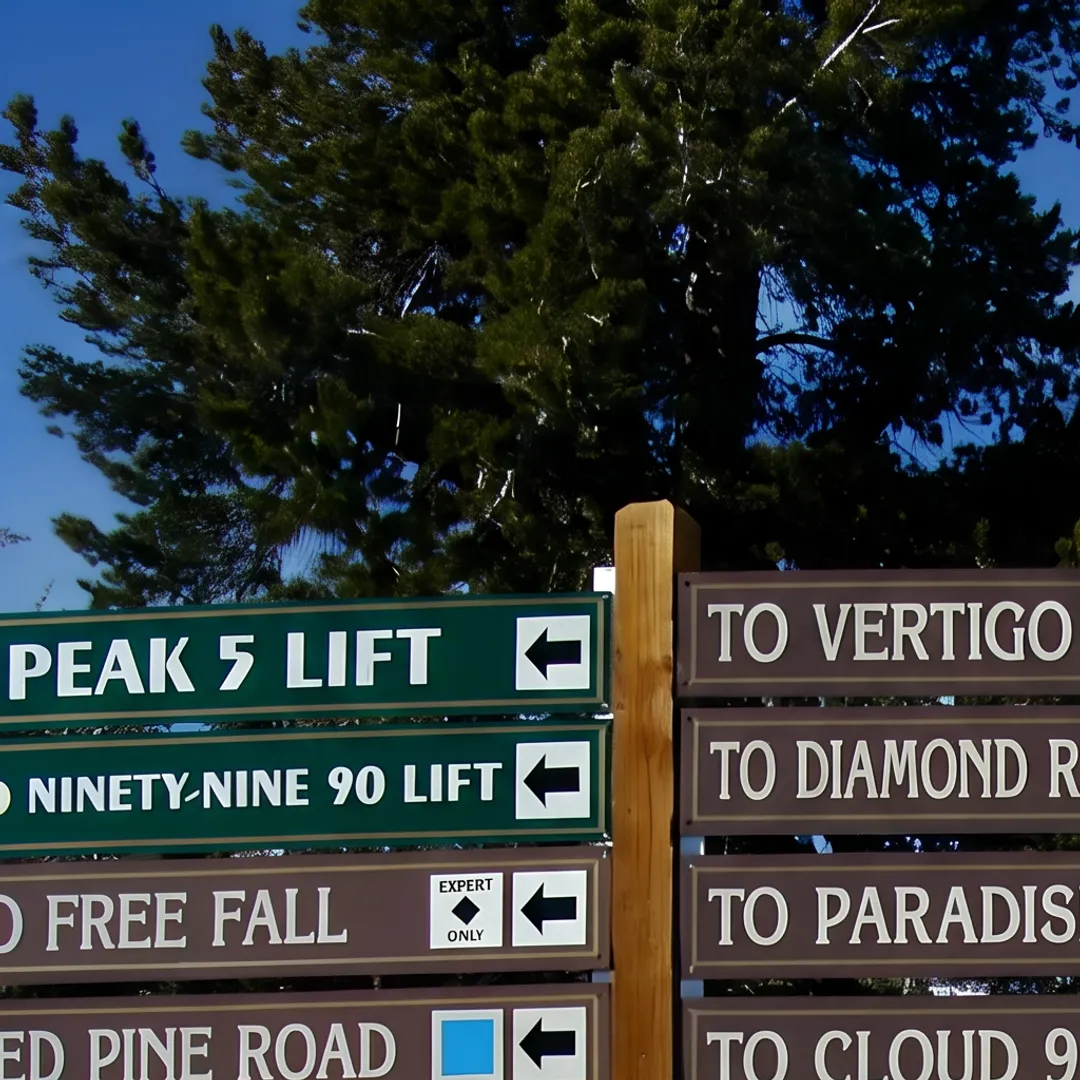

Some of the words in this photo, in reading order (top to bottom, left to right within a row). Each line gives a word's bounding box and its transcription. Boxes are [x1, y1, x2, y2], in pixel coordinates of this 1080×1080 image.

[707, 602, 788, 663] TO
[812, 600, 1073, 662] VERTIGO
[8, 636, 196, 701] PEAK
[219, 634, 255, 691] 5
[286, 627, 442, 689] LIFT
[28, 768, 309, 814] NINETY-NINE
[327, 765, 386, 805] 90
[403, 762, 503, 803] LIFT
[709, 739, 776, 801] TO
[795, 738, 1028, 800] DIAMOND
[439, 878, 494, 894] EXPERT
[707, 886, 789, 946] TO
[45, 891, 187, 952] FREE
[211, 886, 348, 947] FALL
[447, 929, 484, 943] ONLY
